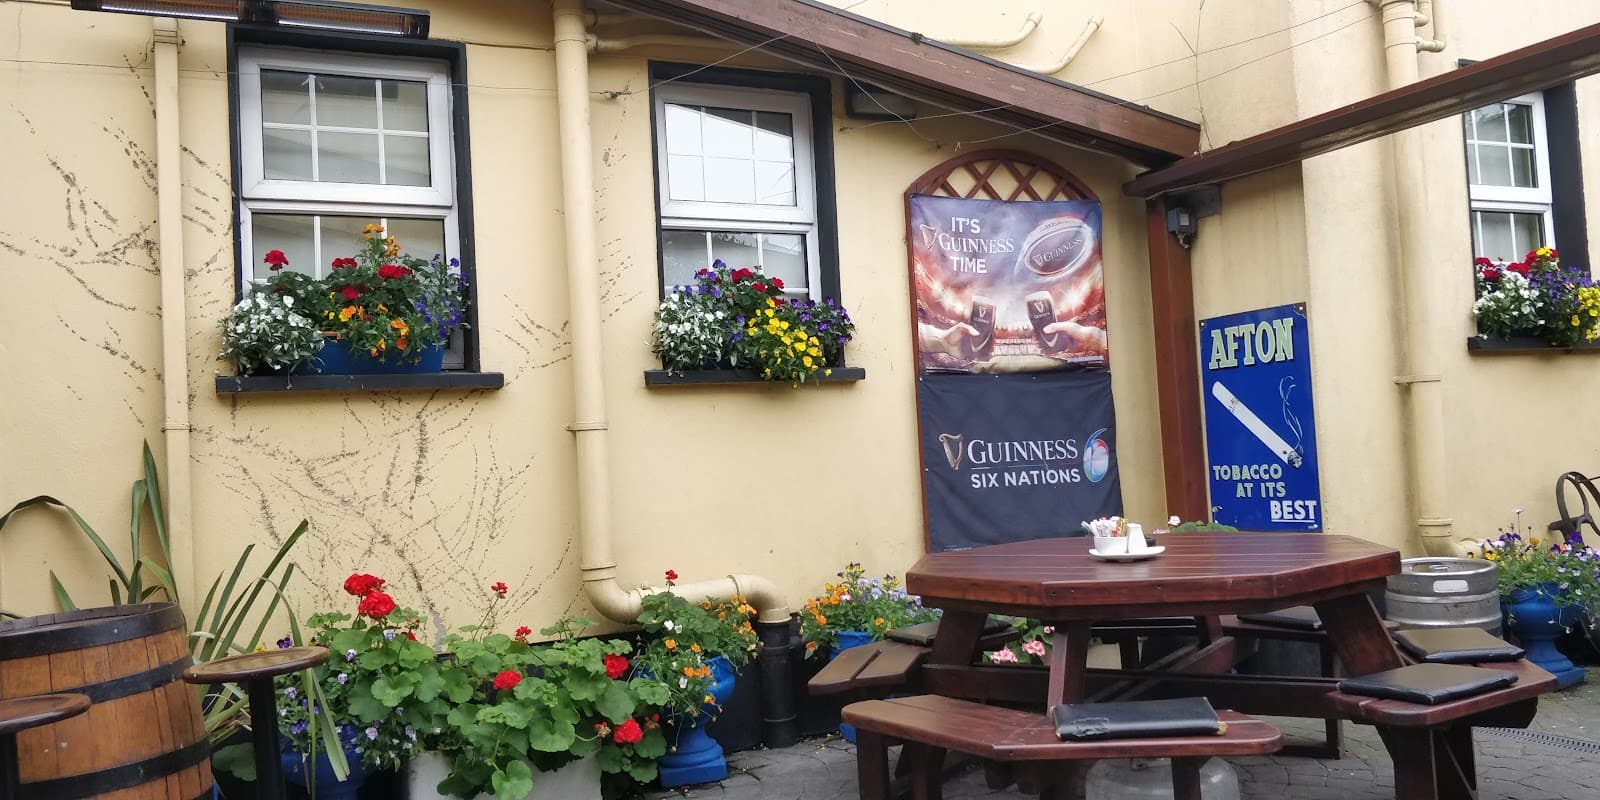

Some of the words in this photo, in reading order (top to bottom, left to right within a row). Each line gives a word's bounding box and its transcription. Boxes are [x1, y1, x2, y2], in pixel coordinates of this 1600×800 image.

[951, 216, 981, 233] IT'S
[938, 232, 1015, 254] GUINNESS
[950, 256, 988, 274] TIME
[1208, 317, 1294, 370] AFTON
[967, 438, 1079, 464] GUINNESS
[971, 472, 999, 489] SIX
[1004, 468, 1081, 487] NATIONS
[1212, 463, 1283, 480] TOBACCO
[1236, 482, 1254, 498] AT
[1260, 481, 1287, 498] ITS
[1270, 500, 1317, 520] BEST
